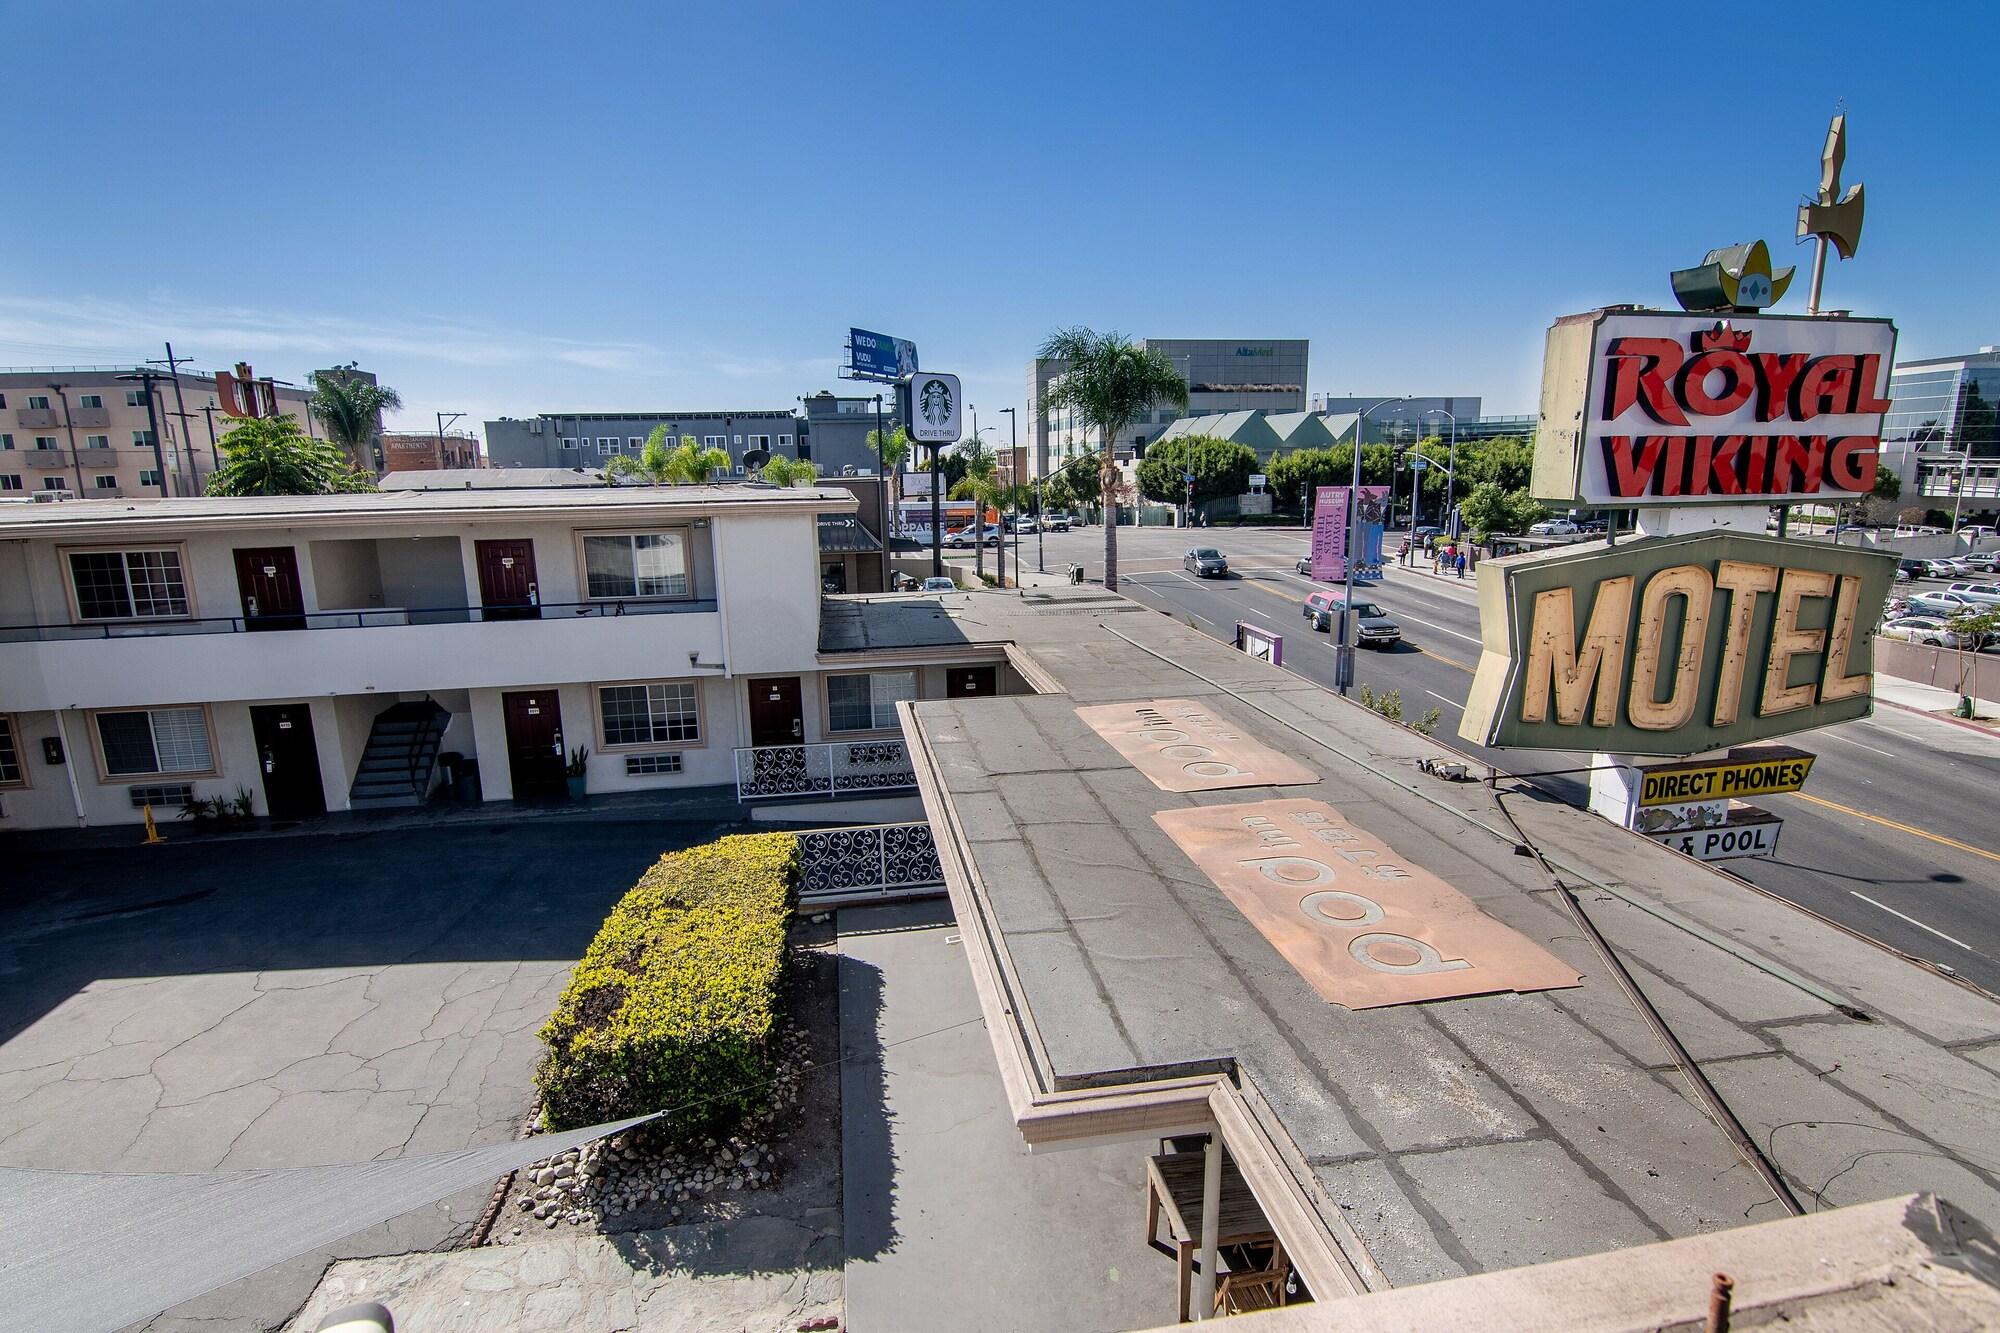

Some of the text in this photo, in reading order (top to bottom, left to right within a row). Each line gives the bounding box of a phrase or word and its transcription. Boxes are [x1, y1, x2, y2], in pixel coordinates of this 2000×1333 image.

[1602, 337, 1892, 427] ROYAL
[1601, 435, 1880, 498] VIKING
[1319, 491, 1345, 499] AUTRY
[1316, 514, 1325, 538] THE
[1323, 514, 1334, 554] LEAVES
[1332, 514, 1341, 559] COYOTE
[1520, 559, 1873, 731] MOTEL
[1644, 763, 1804, 800] DIRECT PHONES
[1704, 829, 1766, 855] POOL
